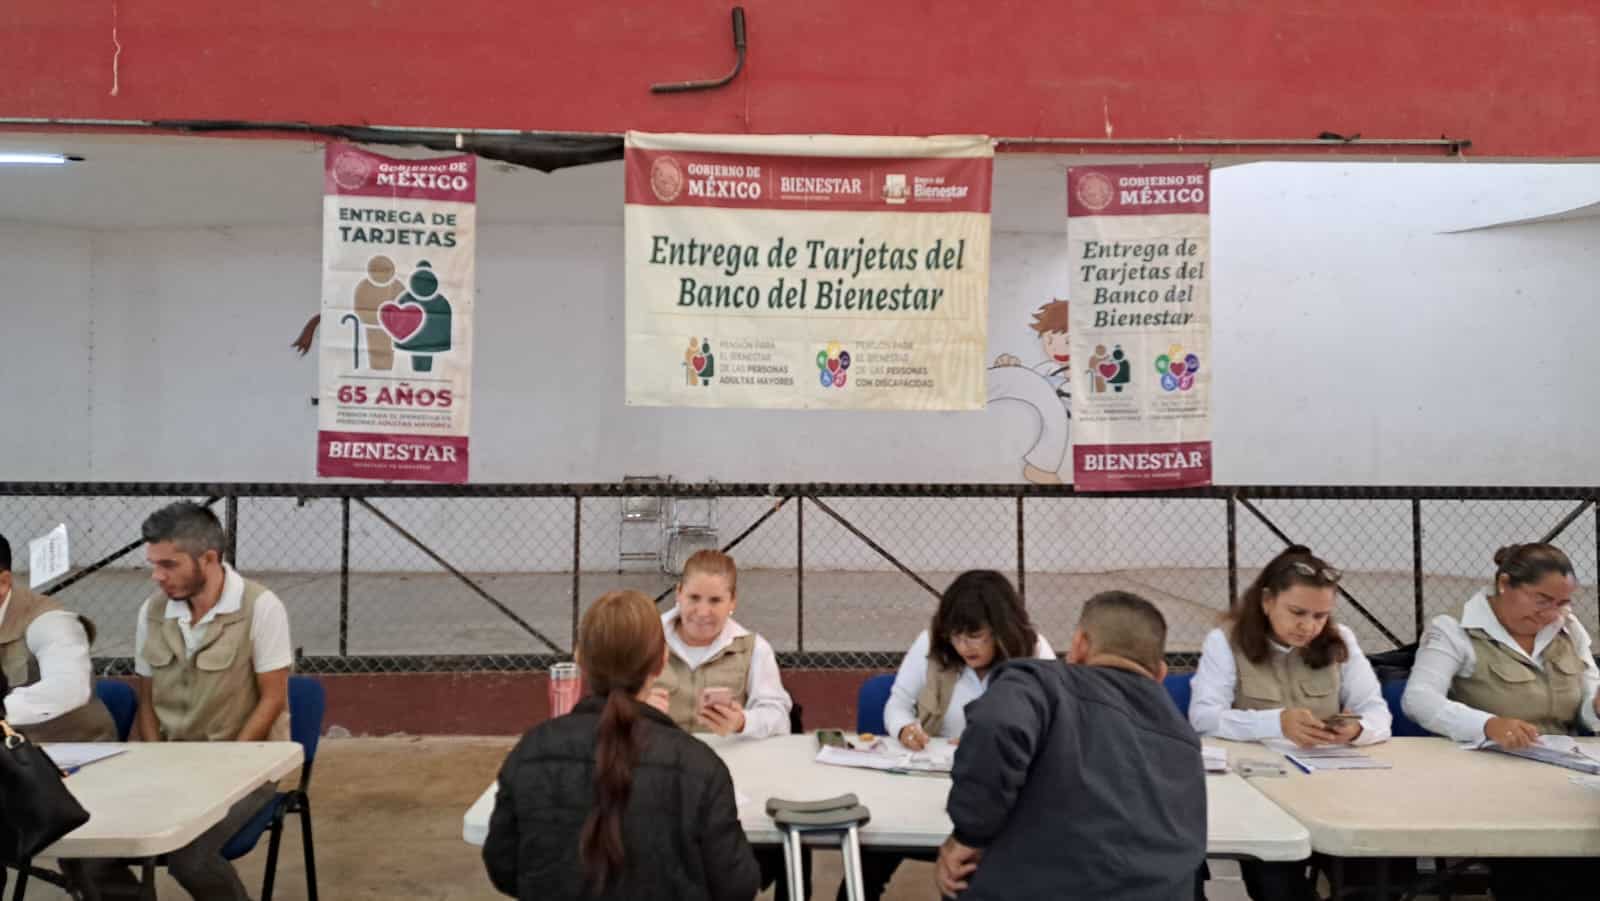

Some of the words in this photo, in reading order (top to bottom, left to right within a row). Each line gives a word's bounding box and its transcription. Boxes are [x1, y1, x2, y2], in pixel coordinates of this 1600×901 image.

[449, 162, 468, 172] DE
[688, 163, 744, 177] GOBIERNO
[746, 166, 761, 178] DE
[376, 171, 468, 190] MÉXICO
[688, 175, 761, 199] MÉXICO
[781, 177, 861, 194] BIENESTAR
[1119, 177, 1184, 187] GOBIERNO
[1187, 175, 1204, 185] DE
[914, 185, 969, 198] Bienestar
[1119, 186, 1204, 205] MÉXICO
[339, 208, 426, 225] ENTREGA
[432, 213, 457, 226] DE
[339, 227, 457, 247] TARJETAS
[649, 235, 759, 276] Entrega
[767, 237, 798, 270] de
[806, 237, 917, 278] Tarjetas
[925, 238, 965, 270] del
[1082, 240, 1169, 262] Entrega
[1175, 237, 1197, 257] de
[1081, 262, 1170, 285] Tarjetas
[1176, 261, 1205, 280] del
[677, 278, 760, 309] Banco
[768, 277, 807, 309] del
[814, 278, 944, 311] Bienestar
[1094, 287, 1159, 305] Banco
[1164, 284, 1194, 303] del
[1094, 308, 1194, 328] Bienestar
[748, 365, 788, 374] PERSONAS
[719, 376, 755, 385] ADULTAS
[757, 377, 794, 386] MAYORES
[337, 385, 368, 404] 65
[375, 382, 453, 407] AÑOS
[328, 441, 457, 462] BIENESTAR
[1084, 451, 1203, 471] BIENESTAR
